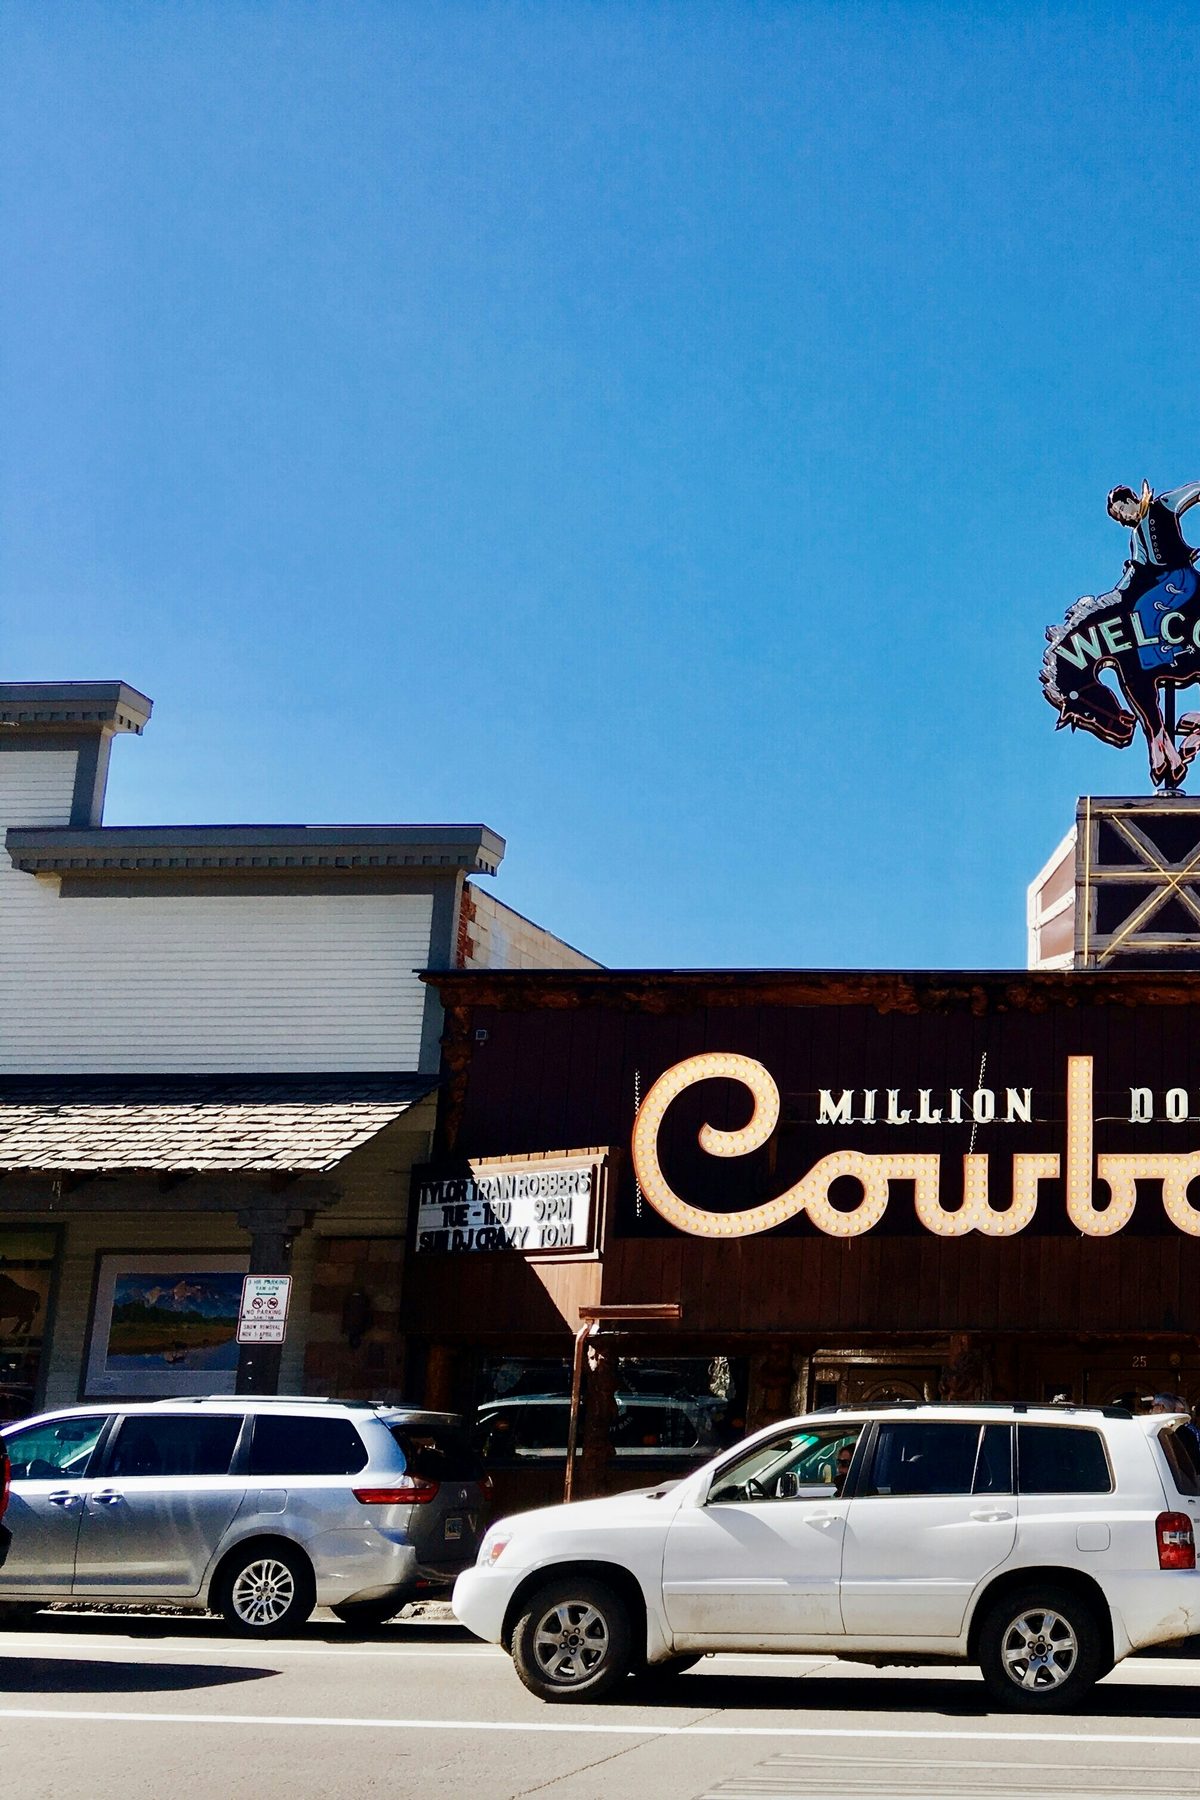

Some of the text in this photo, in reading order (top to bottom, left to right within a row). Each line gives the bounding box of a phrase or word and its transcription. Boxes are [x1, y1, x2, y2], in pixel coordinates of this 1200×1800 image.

[816, 1088, 1033, 1125] MILLION
[420, 1170, 592, 1204] TYLOR TRAIN ROBBERS
[534, 1198, 573, 1223] 9PM
[419, 1229, 449, 1251] SUN
[453, 1228, 474, 1250] DJ
[539, 1224, 574, 1247] TOM
[1132, 1355, 1147, 1368] 25
